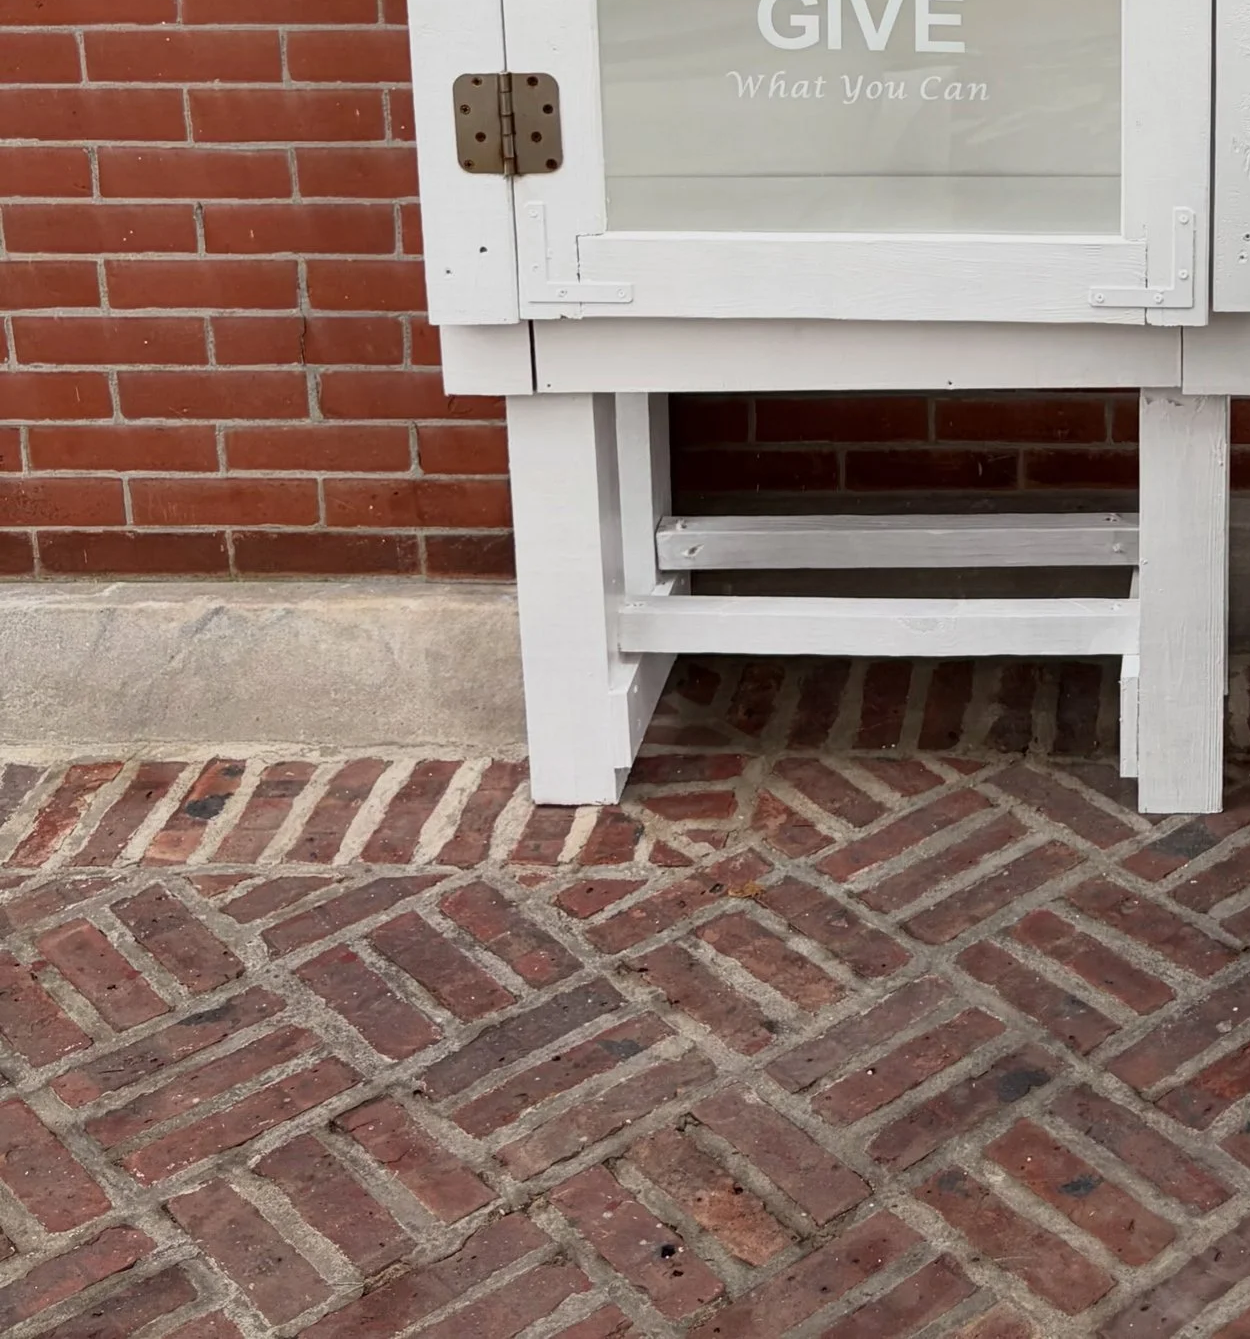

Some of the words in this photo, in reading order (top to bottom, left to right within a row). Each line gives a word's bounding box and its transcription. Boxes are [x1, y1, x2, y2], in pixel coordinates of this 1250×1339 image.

[725, 70, 826, 100] What
[840, 73, 908, 105] You
[919, 76, 990, 102] Can
